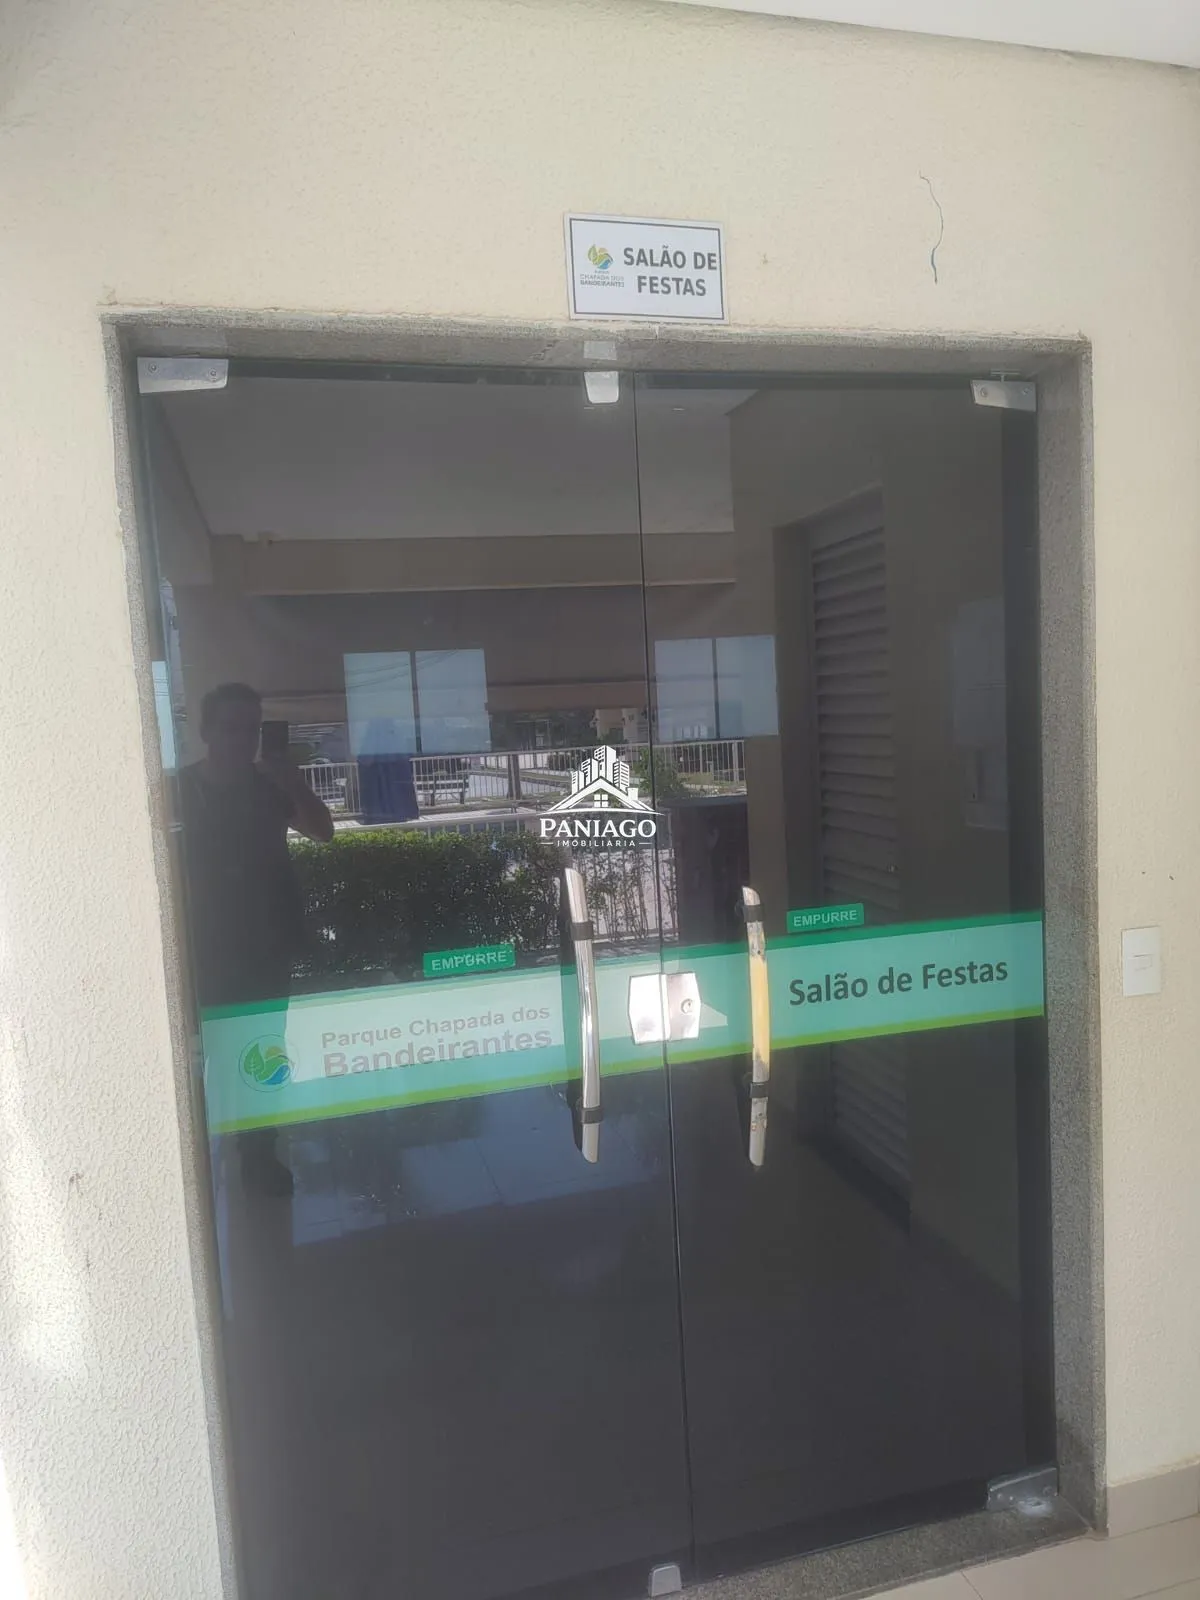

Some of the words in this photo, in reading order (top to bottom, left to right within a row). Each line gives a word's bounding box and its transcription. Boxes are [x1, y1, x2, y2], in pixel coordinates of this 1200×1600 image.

[623, 245, 686, 269] SALÃO
[693, 251, 717, 271] DE
[637, 275, 706, 297] FESTAS
[793, 909, 857, 928] EMPURRE
[431, 950, 507, 971] EMPURRE
[789, 972, 868, 1006] Salão
[877, 966, 913, 995] de
[922, 960, 1008, 990] Festas
[321, 1025, 402, 1049] Parque
[408, 1010, 505, 1036] Chapada
[512, 1006, 550, 1023] dos
[323, 1029, 552, 1078] Bandeirantes
